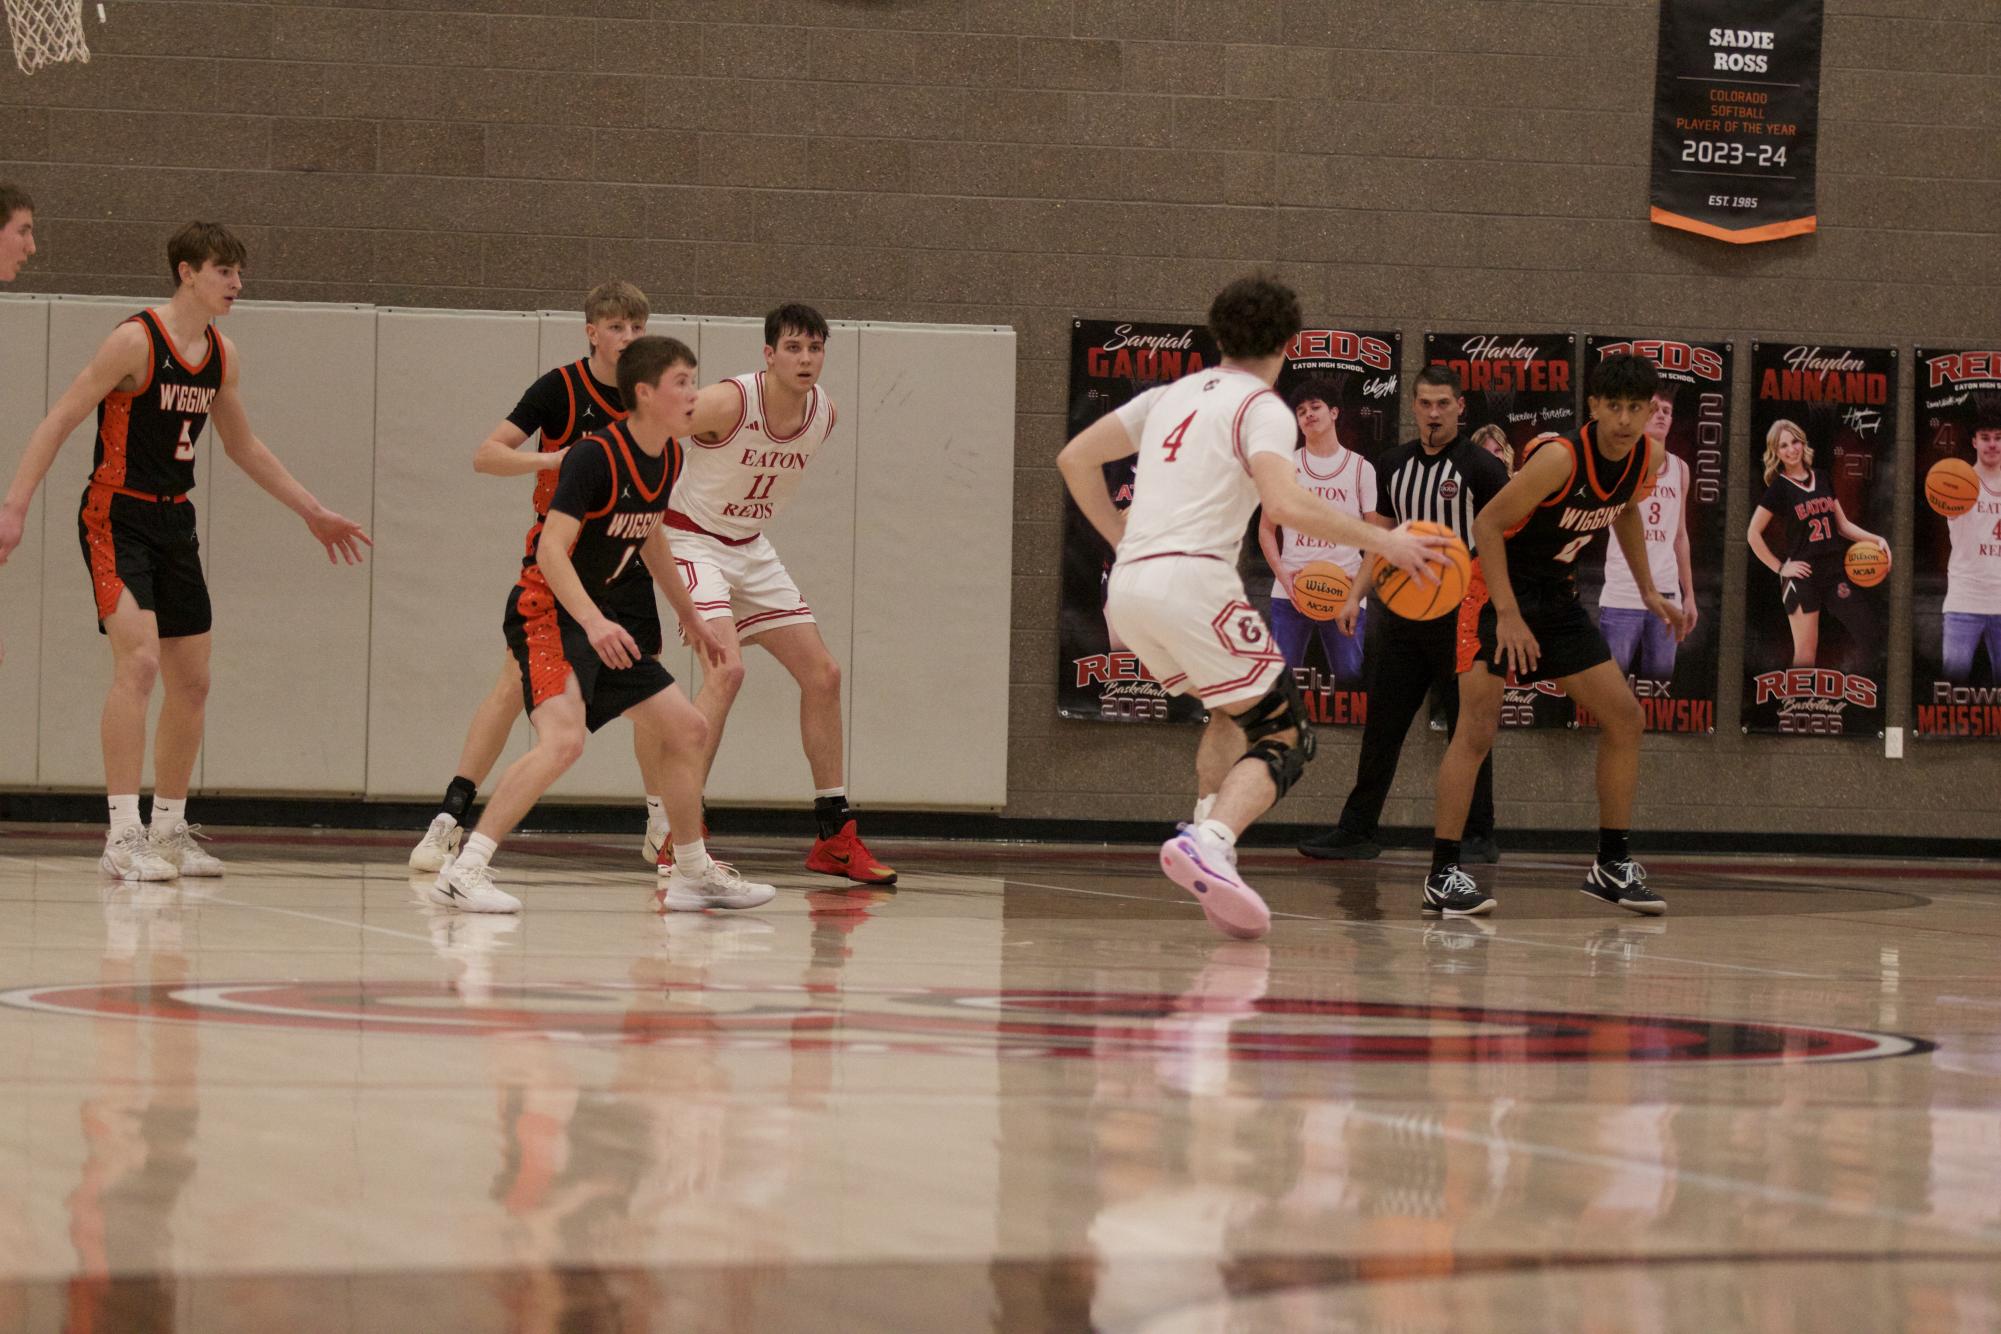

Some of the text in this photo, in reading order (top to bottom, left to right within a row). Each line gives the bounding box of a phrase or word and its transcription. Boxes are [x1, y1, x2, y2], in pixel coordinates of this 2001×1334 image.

[1709, 28, 1774, 49] SADIE
[1714, 53, 1768, 73] ROSS
[1710, 89, 1768, 104] COLORADO
[1711, 105, 1765, 119] SOFTBALL
[1676, 118, 1797, 136] PLAYER OF THE YEAR
[1682, 140, 1788, 167] 2023-24
[1708, 195, 1758, 208] EST. 1985
[1103, 324, 1193, 360] Saryiah
[1461, 335, 1539, 370] Harley
[1292, 362, 1317, 370] EATON
[1336, 363, 1365, 373] SCHOOL
[1783, 345, 1866, 381] Hayden
[1668, 372, 1696, 383] SCHOOL
[1760, 367, 1887, 405] ANNAND
[1162, 409, 1197, 462] 4
[740, 448, 809, 470] EATON
[744, 473, 778, 500] 11
[721, 502, 774, 519] REDS
[1808, 516, 1832, 542] 21
[1306, 579, 1344, 597] Wilson
[1099, 681, 1168, 699] Basketball
[1753, 667, 1878, 709] REDS
[1933, 681, 2001, 704] Row
